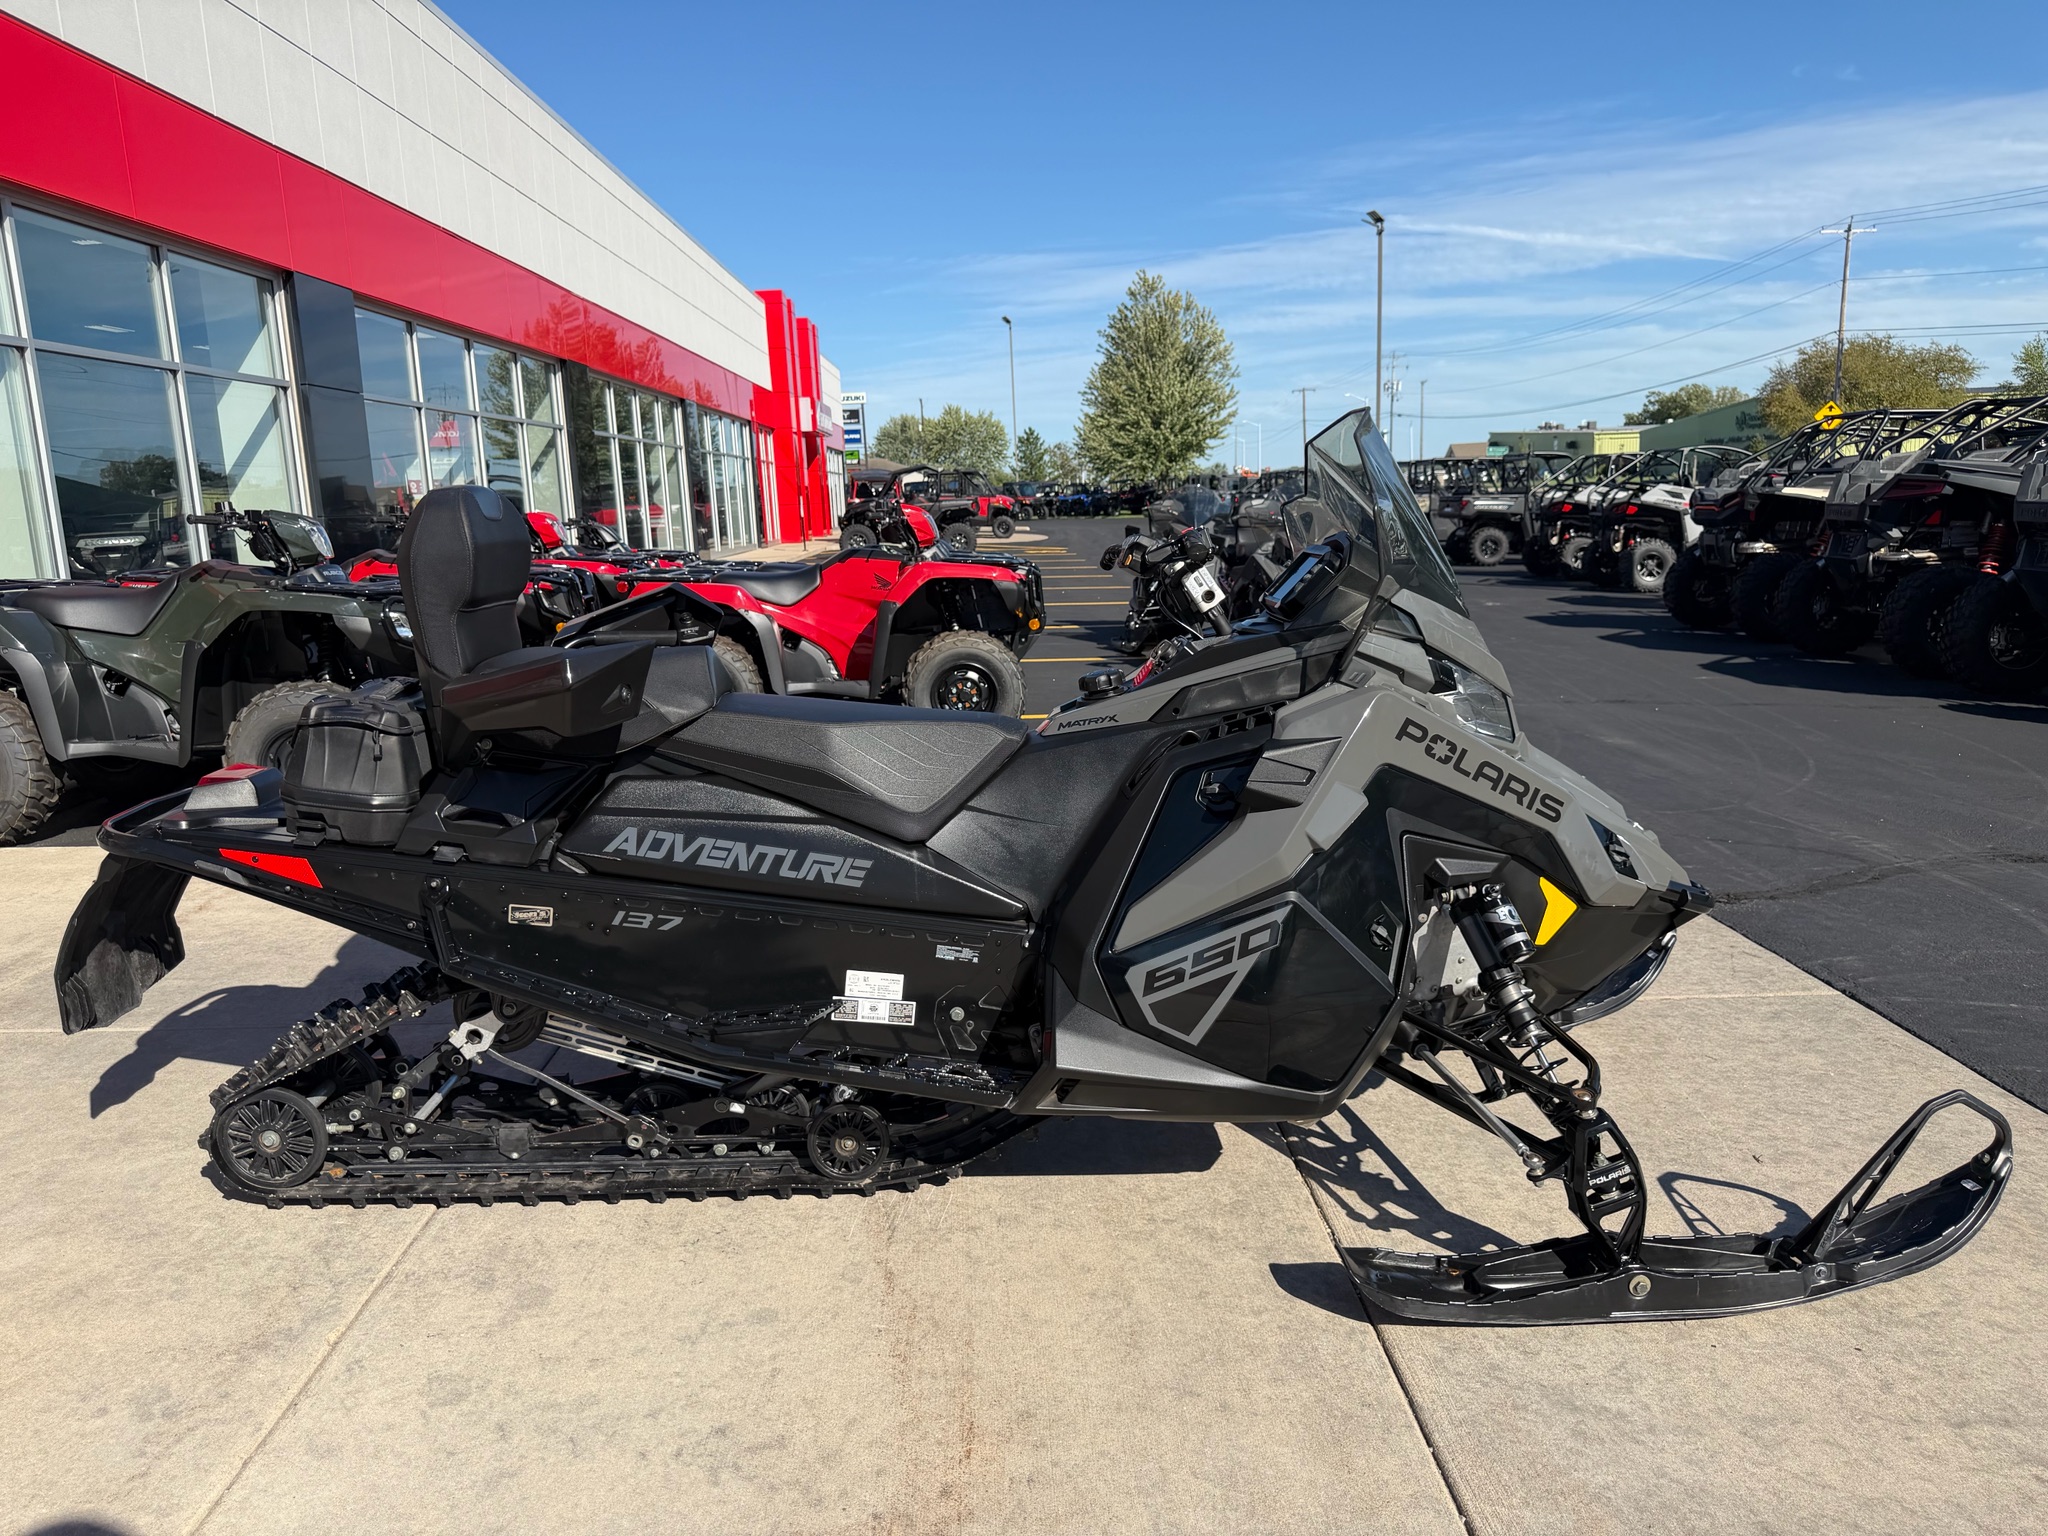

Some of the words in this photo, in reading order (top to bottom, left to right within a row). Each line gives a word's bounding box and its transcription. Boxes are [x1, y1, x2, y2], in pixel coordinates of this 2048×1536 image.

[1057, 714, 1119, 731] MATRYX
[1395, 717, 1565, 823] POLARIS
[602, 826, 874, 887] ADVENTURE
[611, 910, 684, 931] 137
[1142, 919, 1281, 998] 650
[1588, 1164, 1631, 1187] POLARIS
